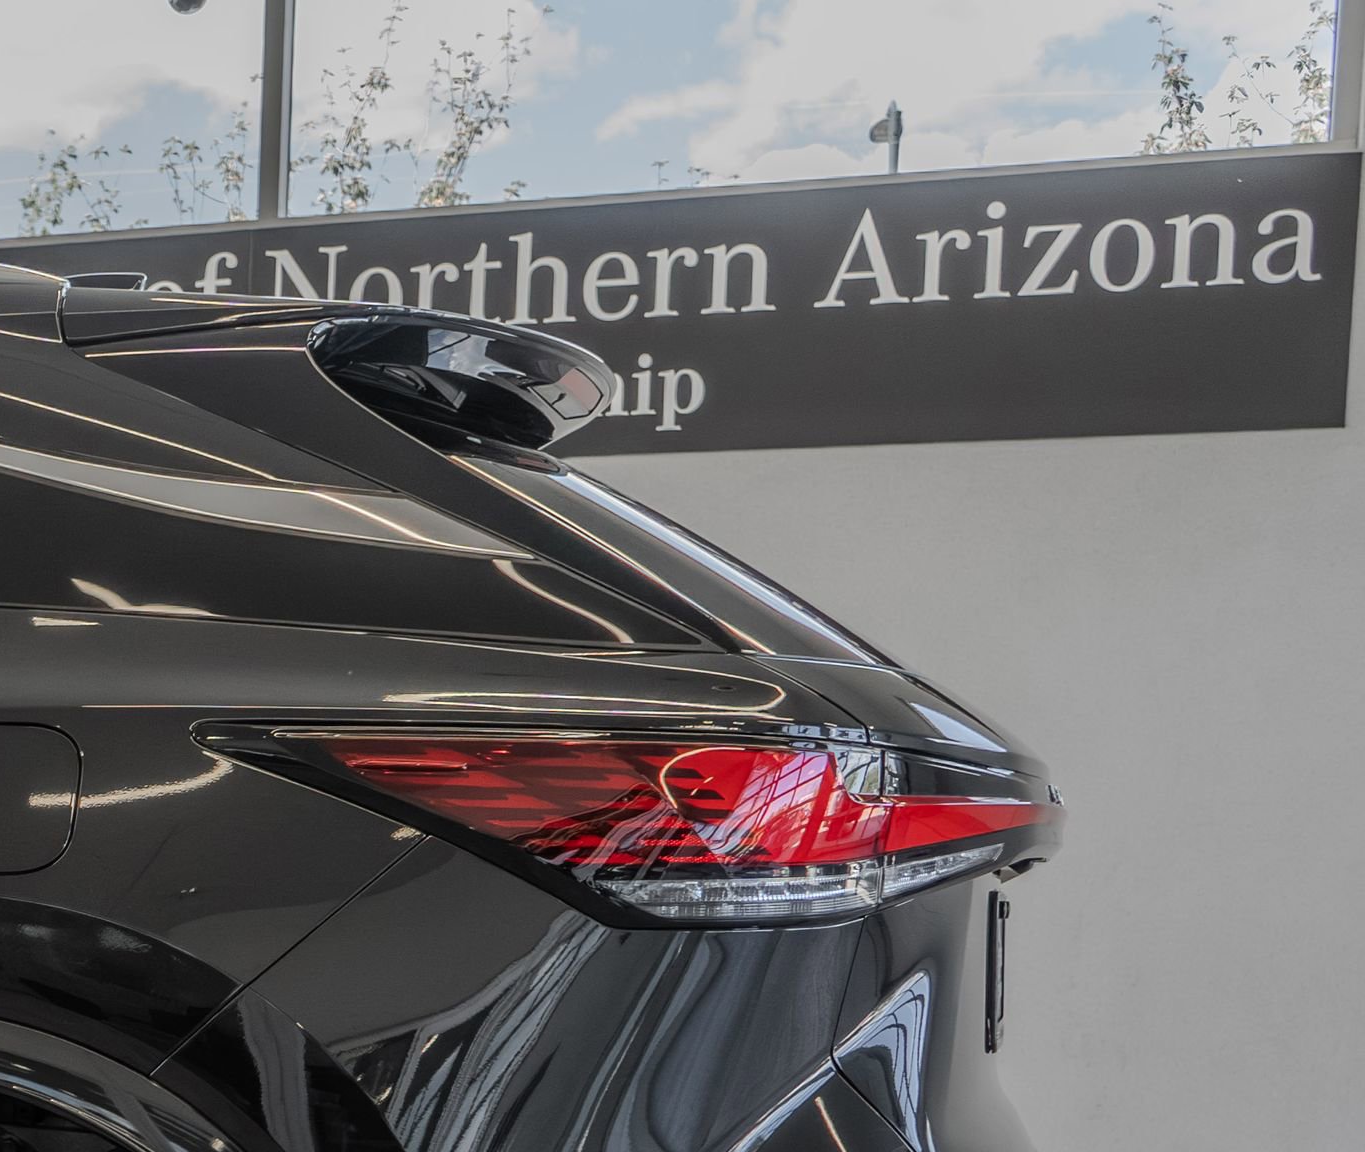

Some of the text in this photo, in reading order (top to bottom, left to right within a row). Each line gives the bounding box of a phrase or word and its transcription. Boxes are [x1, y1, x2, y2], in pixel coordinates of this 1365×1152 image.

[146, 201, 1322, 325] f Northern Arizona
